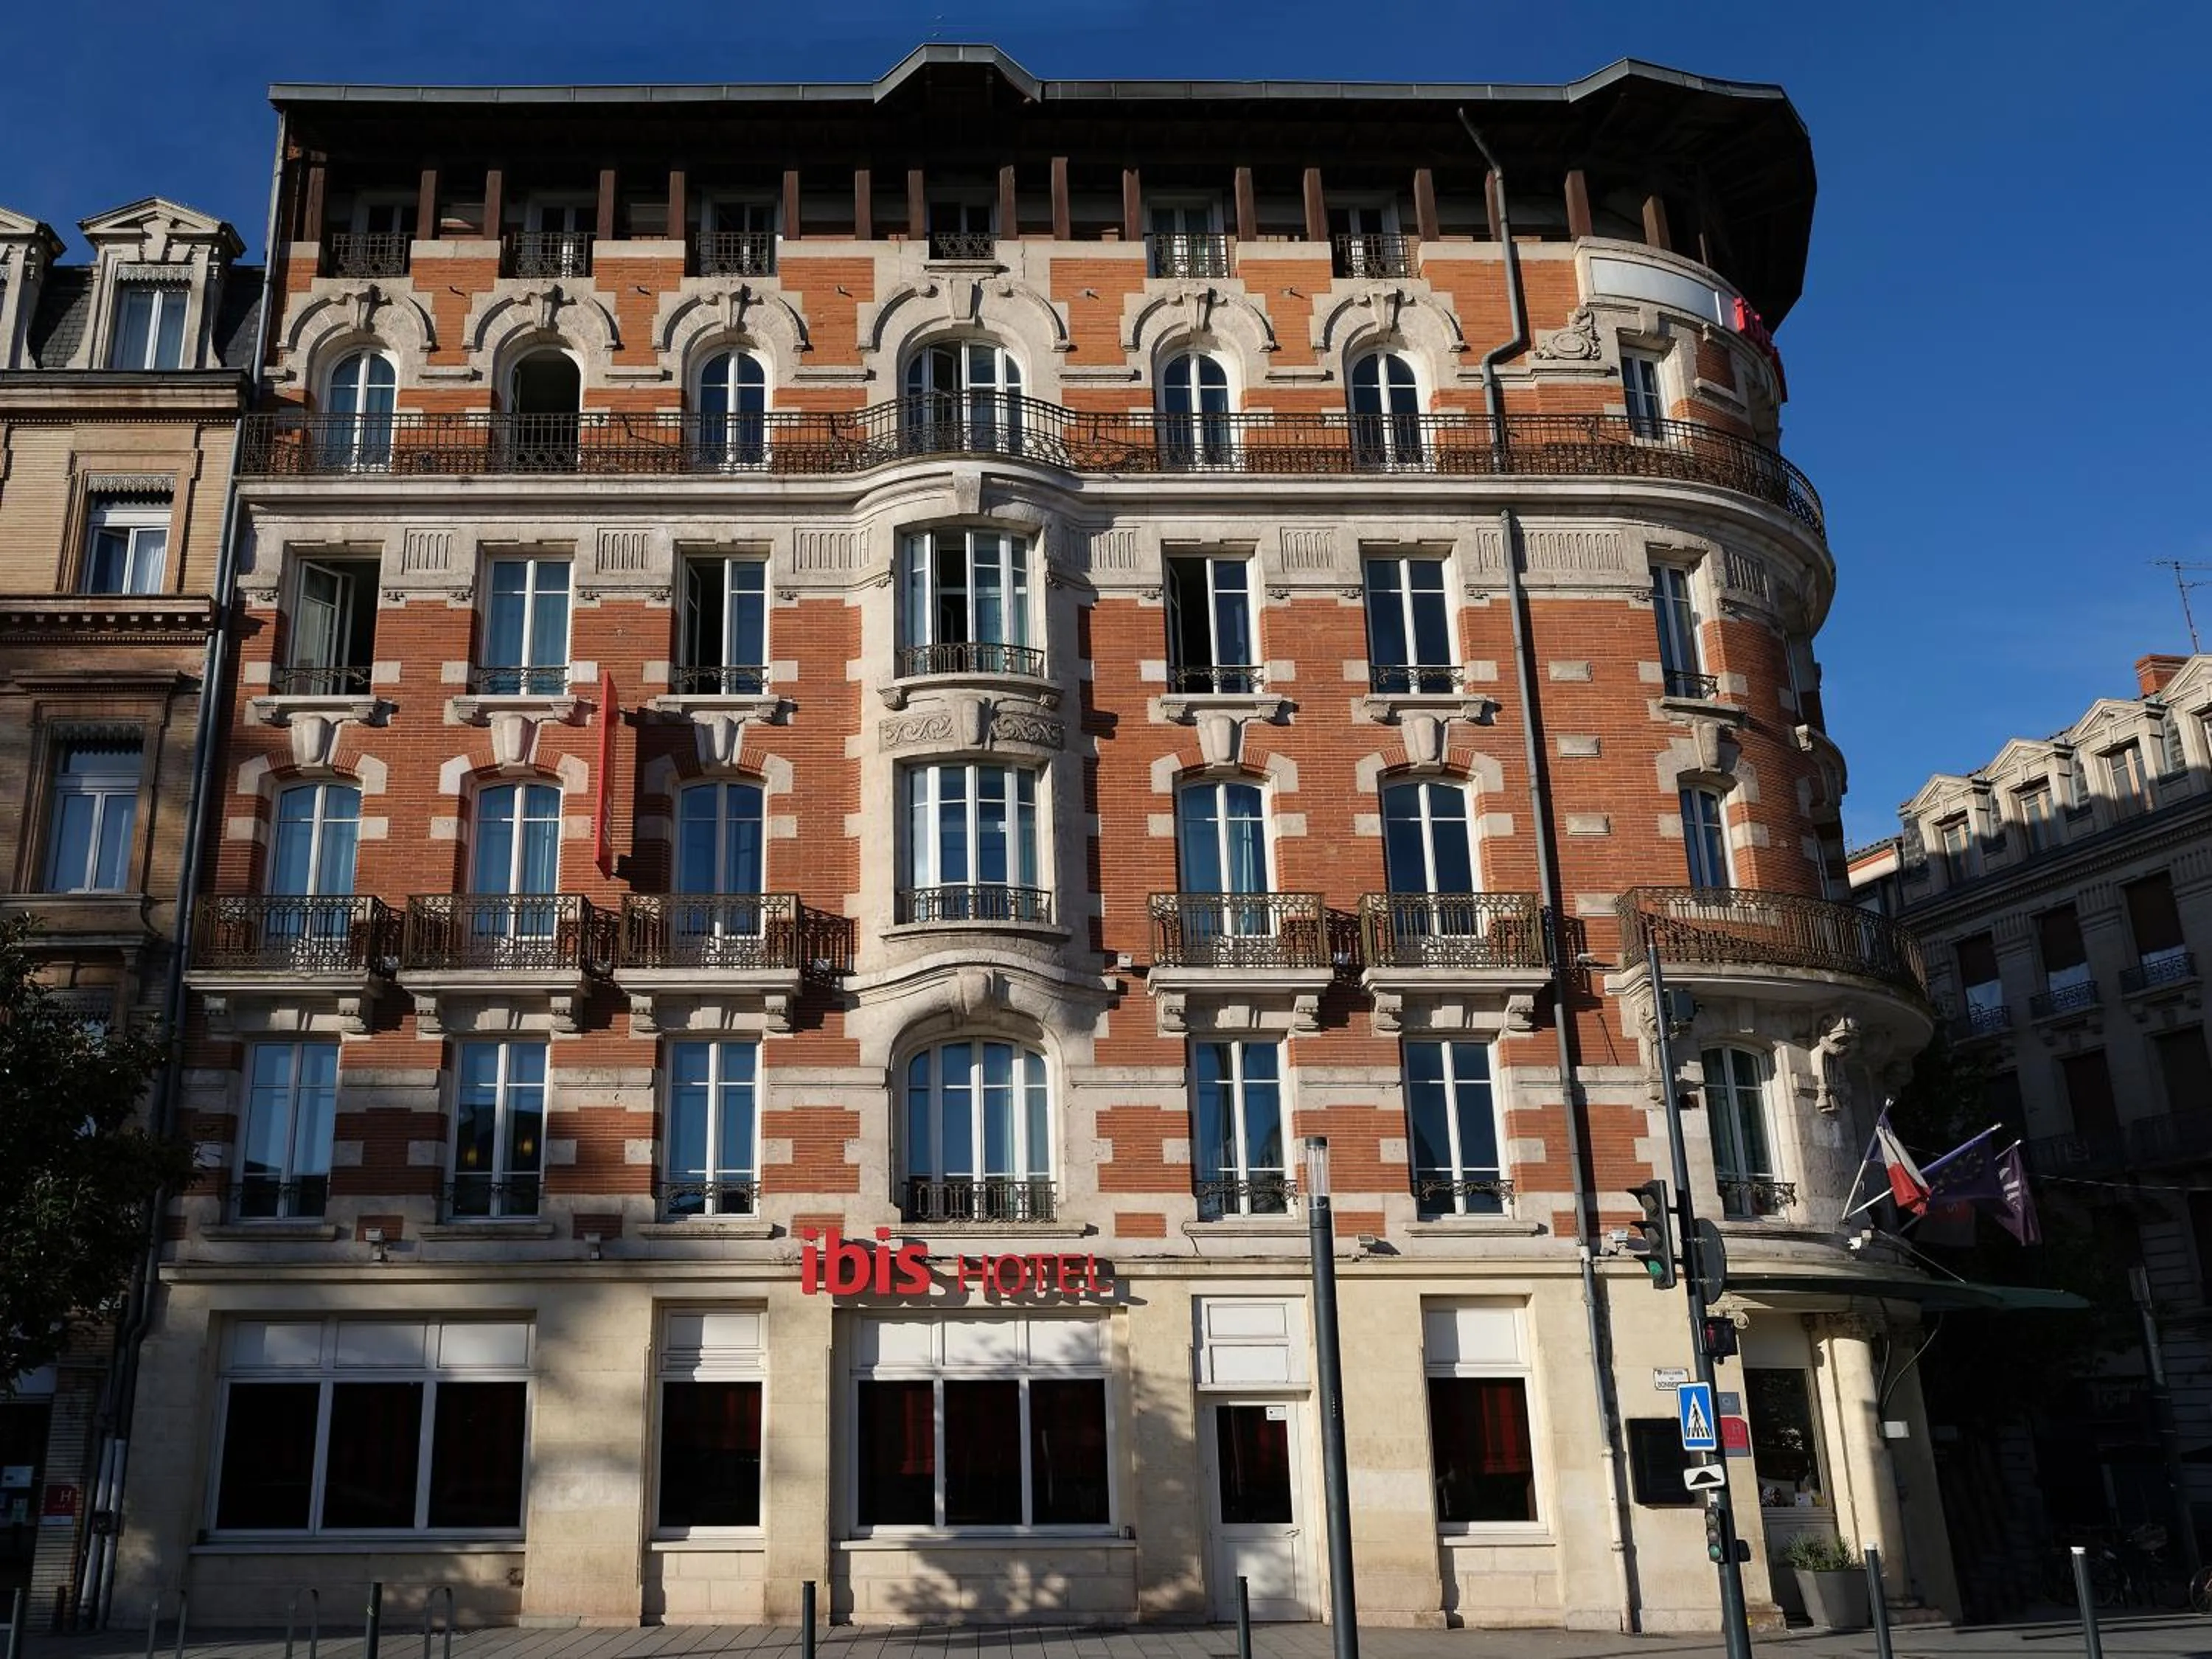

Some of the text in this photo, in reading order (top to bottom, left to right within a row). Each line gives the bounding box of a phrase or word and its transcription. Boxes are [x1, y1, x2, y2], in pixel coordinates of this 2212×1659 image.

[801, 1226, 1113, 1295] ibis HOTEL
[60, 1489, 72, 1502] H
